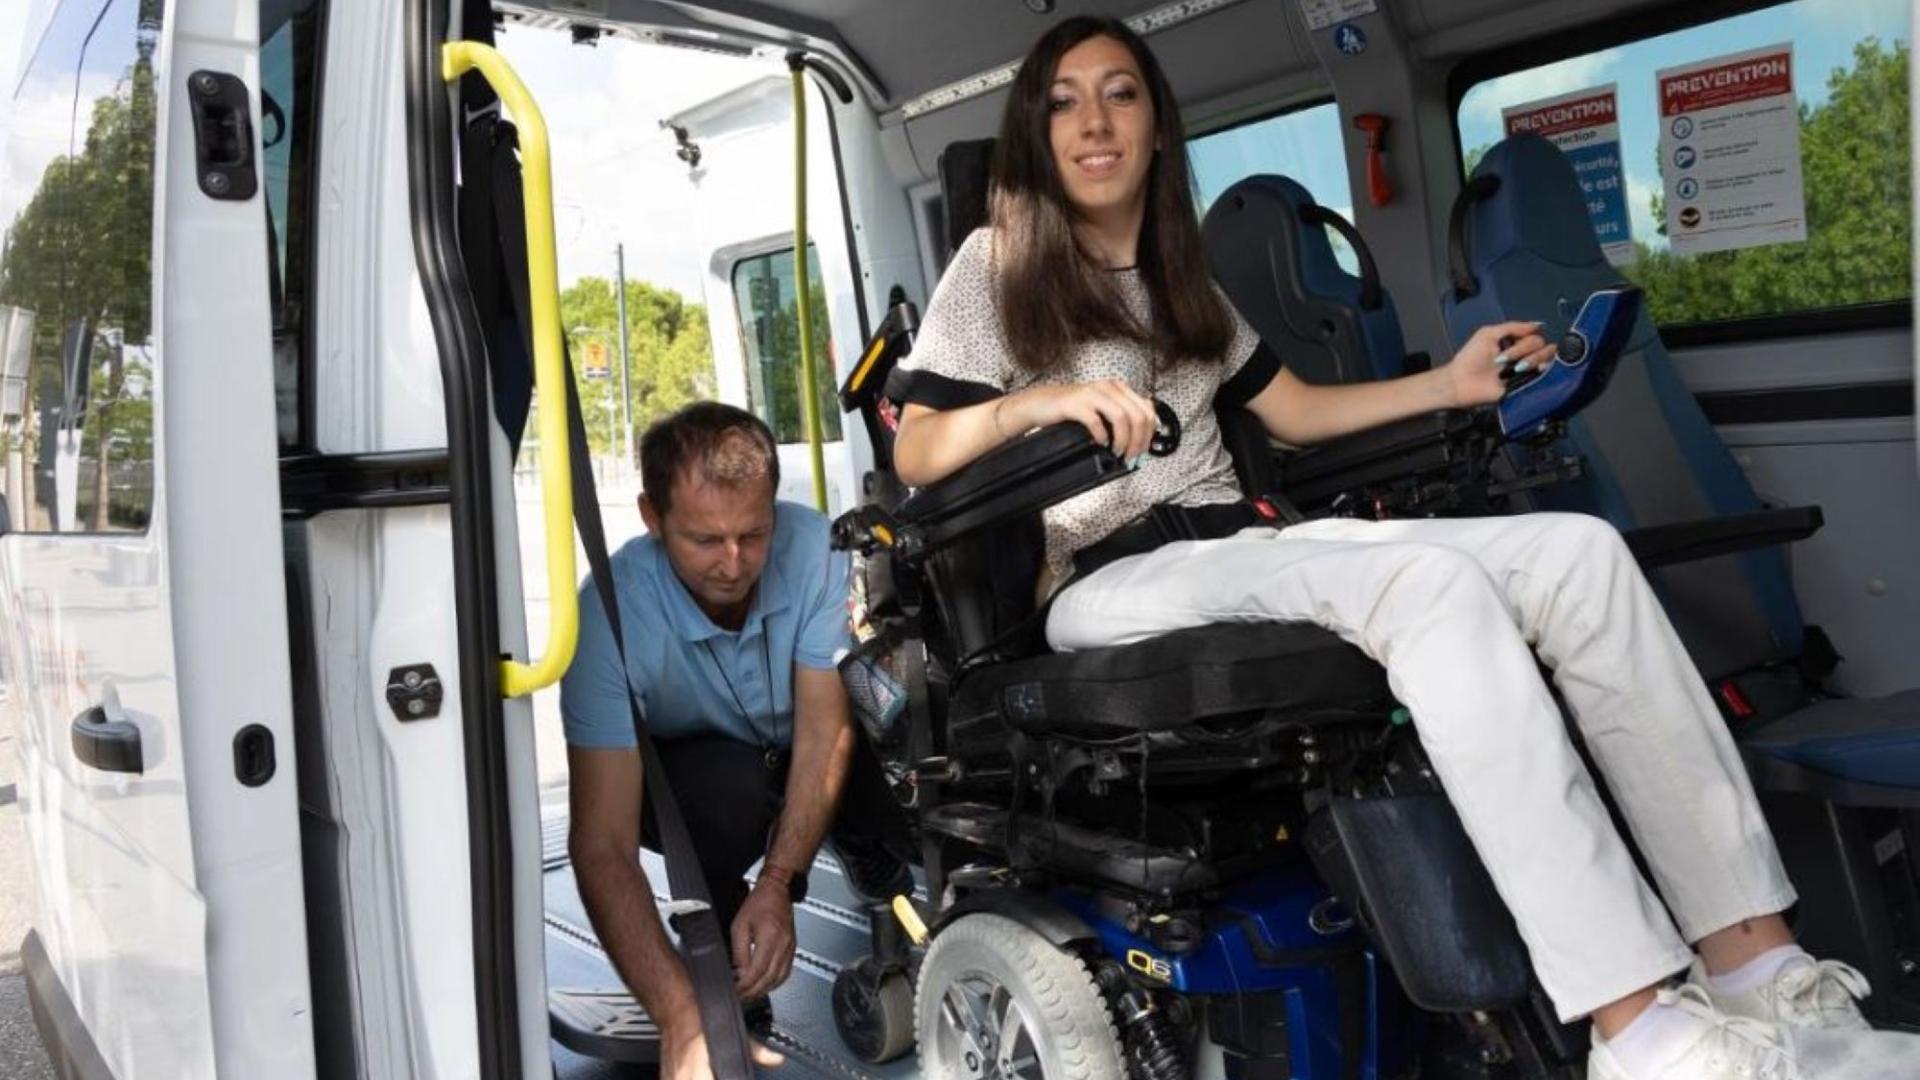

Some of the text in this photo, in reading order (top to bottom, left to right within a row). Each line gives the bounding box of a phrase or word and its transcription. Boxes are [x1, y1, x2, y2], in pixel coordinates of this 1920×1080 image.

[1666, 59, 1787, 97] PREVENTION
[1511, 98, 1614, 132] PREVENTION
[1596, 175, 1618, 191] est
